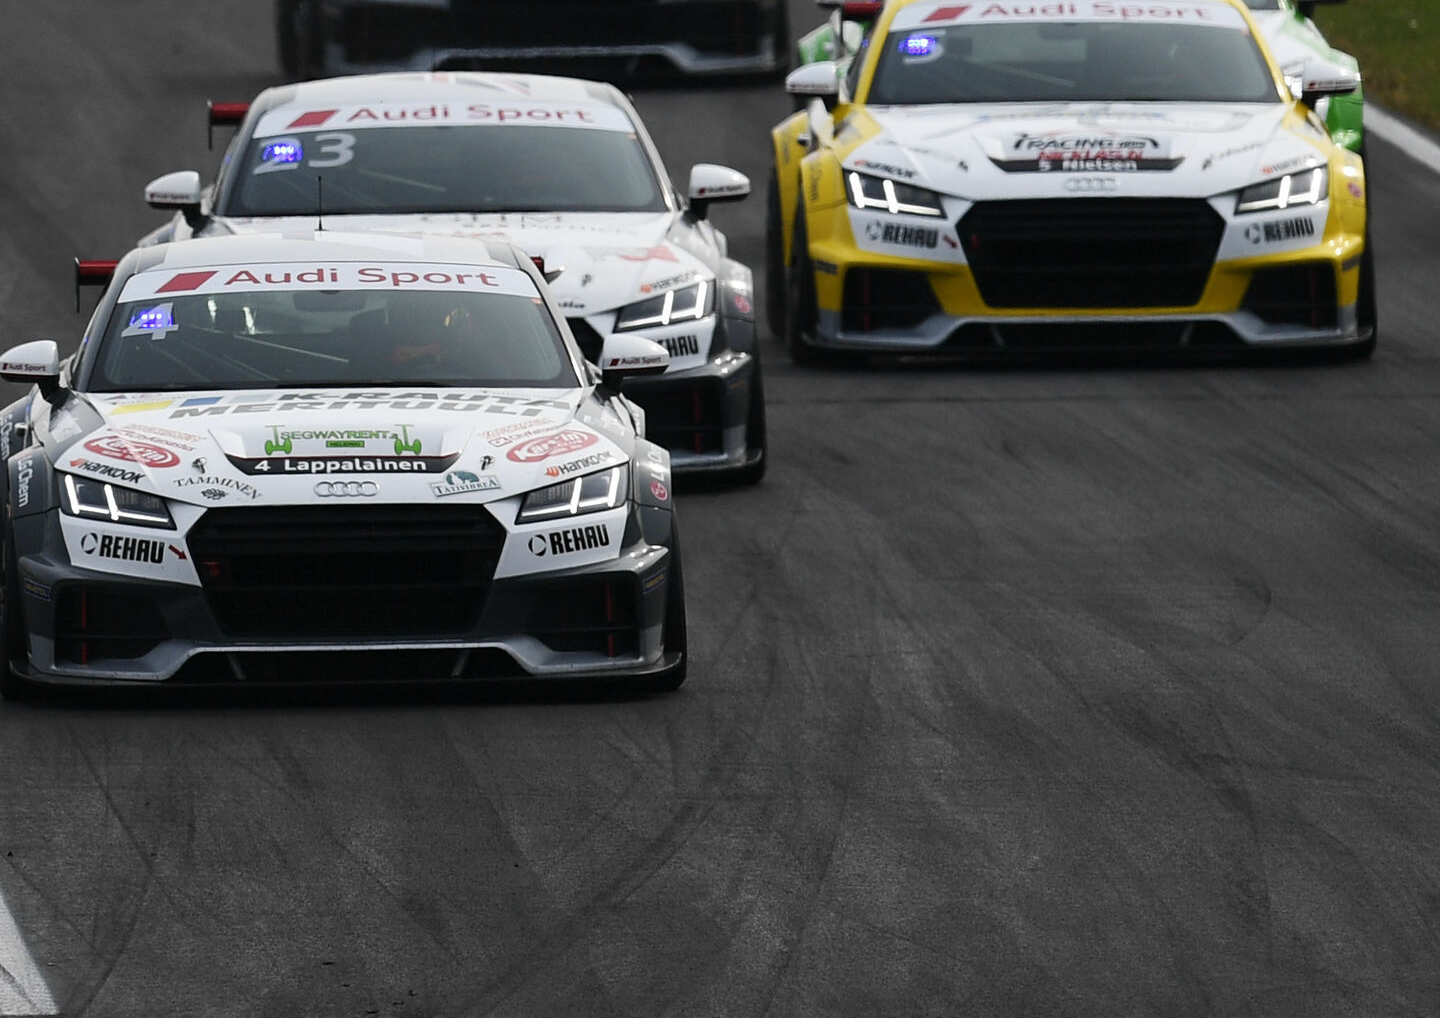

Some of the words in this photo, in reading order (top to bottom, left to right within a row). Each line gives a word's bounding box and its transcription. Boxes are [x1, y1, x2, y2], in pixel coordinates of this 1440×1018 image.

[981, 2, 1077, 17] Audi
[1093, 2, 1213, 18] Sport
[347, 105, 449, 122] Audi
[467, 104, 594, 122] Sport
[253, 132, 357, 174] 23
[1038, 160, 1051, 171] 5
[1062, 160, 1138, 171] Nielsen
[882, 222, 939, 249] REHAU
[1263, 217, 1315, 243] REHAU
[223, 268, 338, 286] Audi
[357, 267, 500, 287] Sport
[121, 301, 179, 341] 4
[24, 363, 46, 373] Sport
[621, 356, 641, 365] Audi
[642, 355, 662, 365] Sport
[168, 400, 545, 420] MERITUULI
[276, 392, 572, 411] K-RAUTA
[17, 454, 33, 470] LG
[253, 459, 272, 472] 4
[283, 458, 427, 474] Lappalainen
[17, 468, 33, 508] Chem
[173, 475, 263, 500] TAMMINEN
[99, 534, 165, 564] REHAU
[549, 524, 611, 555] REHAU
